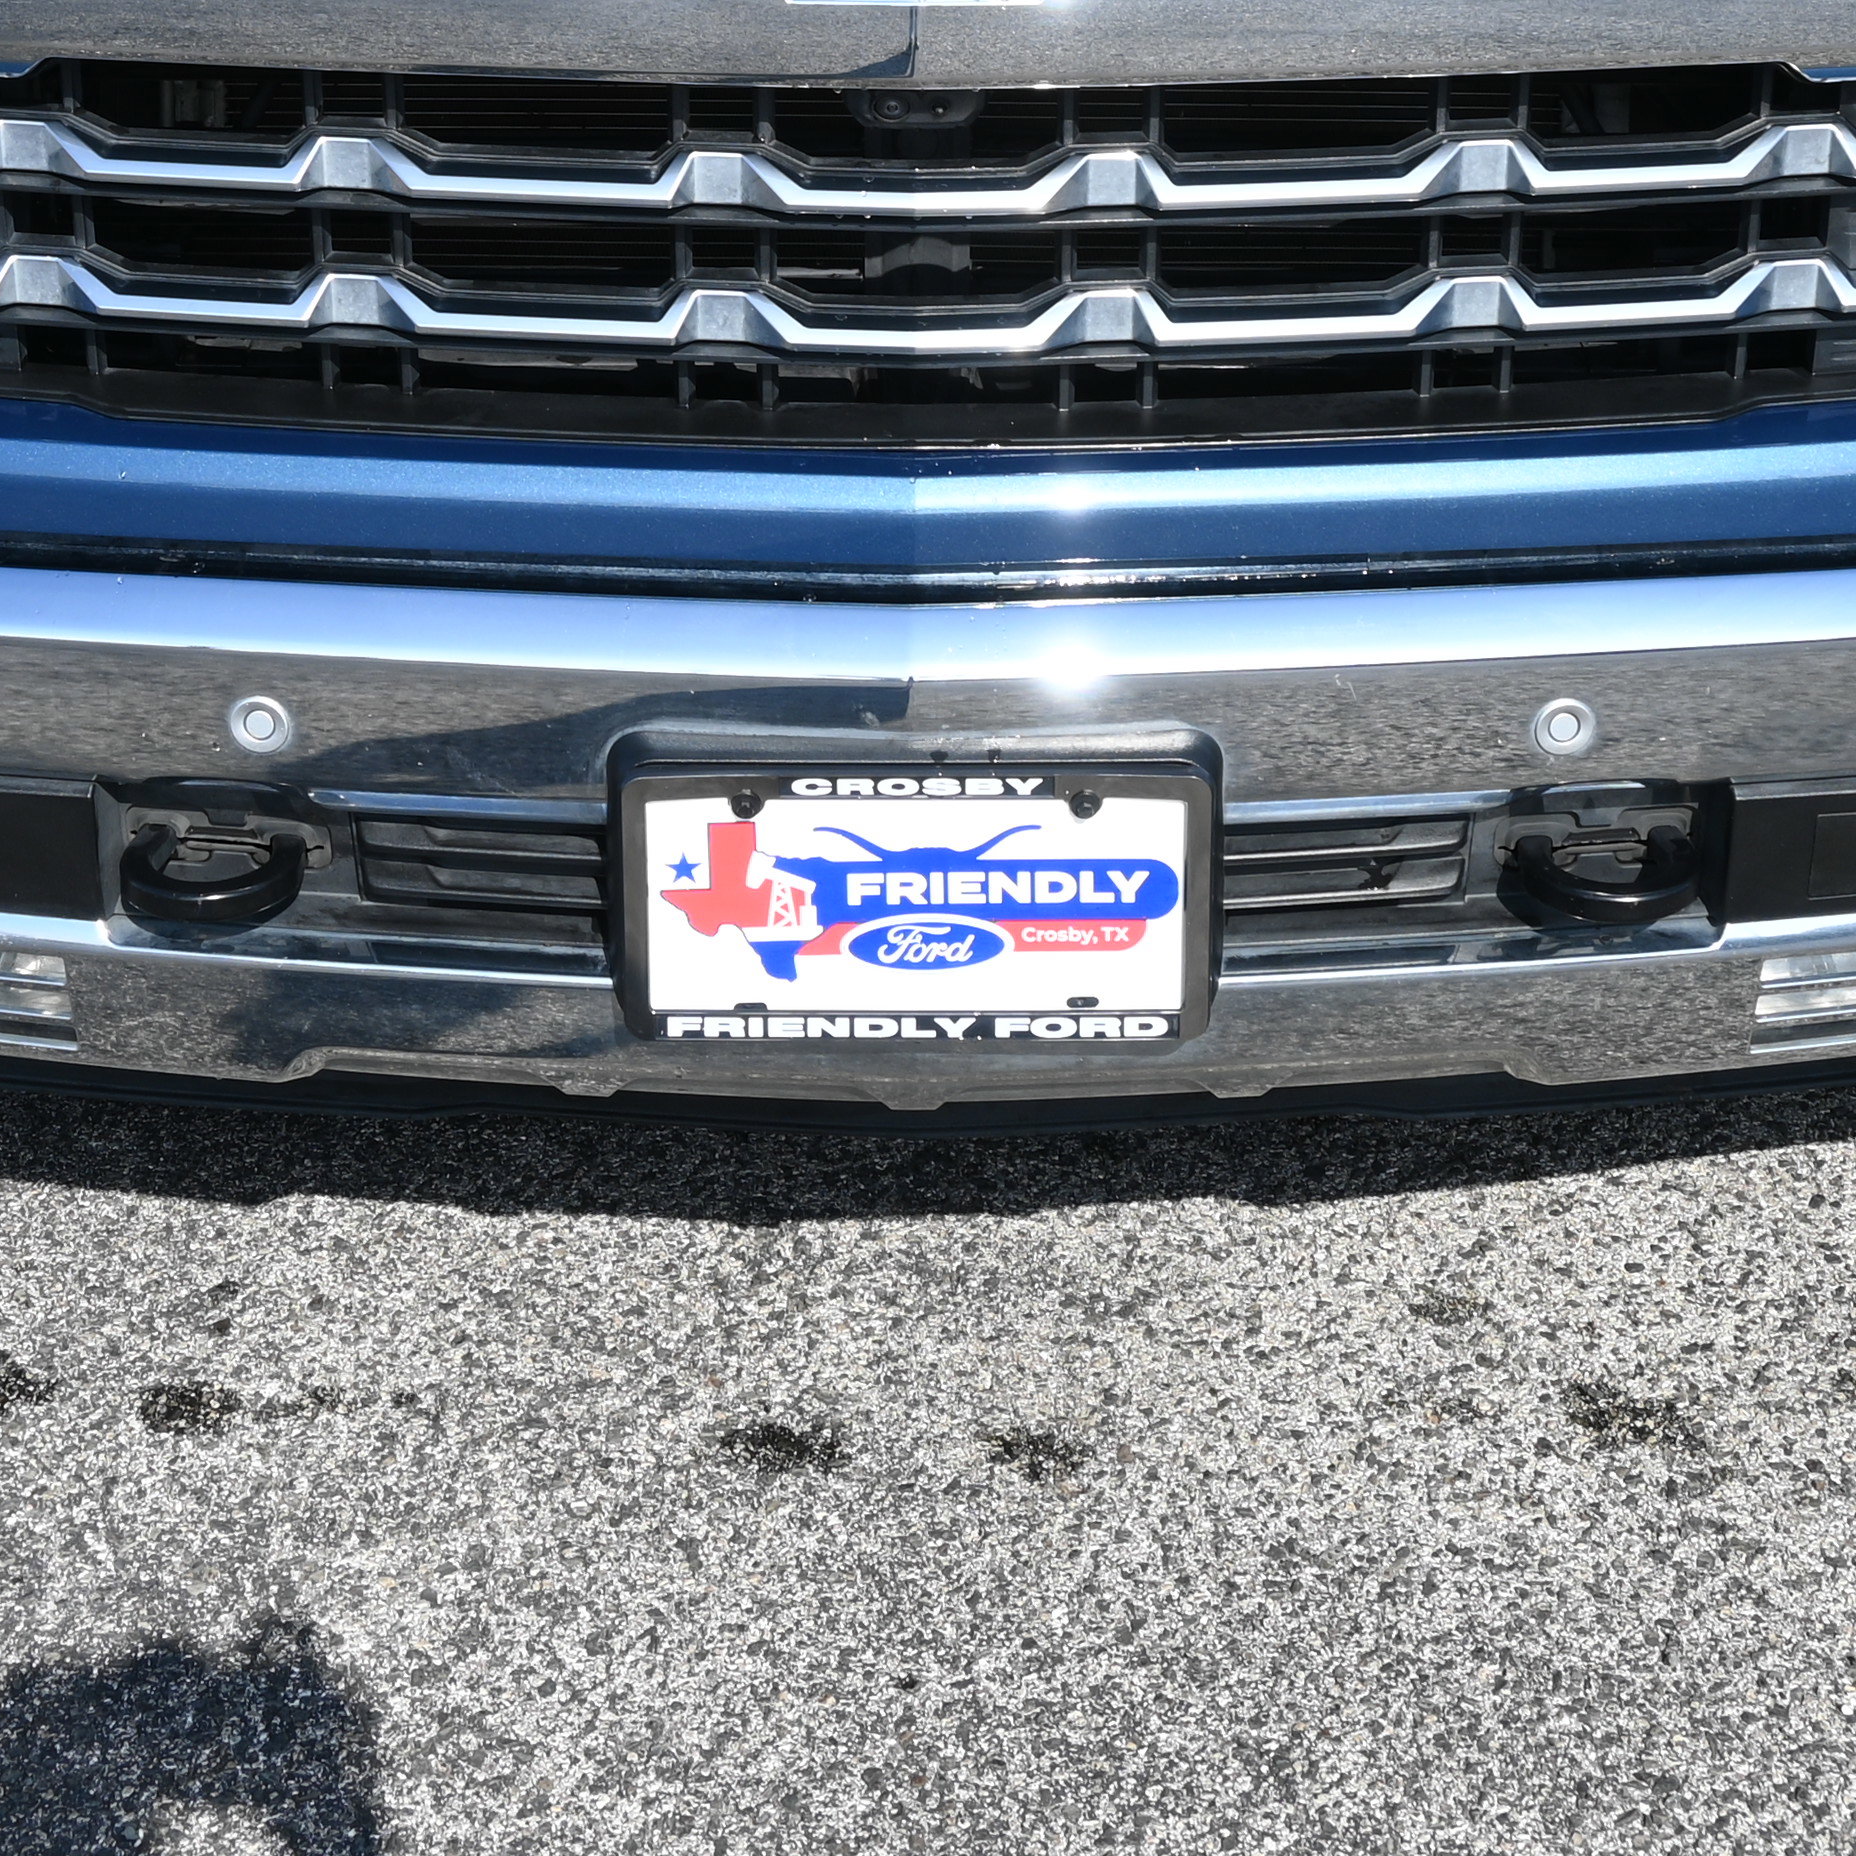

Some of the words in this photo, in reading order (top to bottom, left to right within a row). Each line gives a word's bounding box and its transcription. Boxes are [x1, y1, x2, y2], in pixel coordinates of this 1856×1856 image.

[790, 777, 1044, 797] CROSBY
[847, 872, 1150, 905] FRIENDLY
[877, 924, 976, 965] Ford
[1021, 927, 1099, 946] Crosby,
[1101, 926, 1129, 943] TX
[666, 1016, 977, 1039] FRIENDLY
[994, 1016, 1170, 1039] FORD
